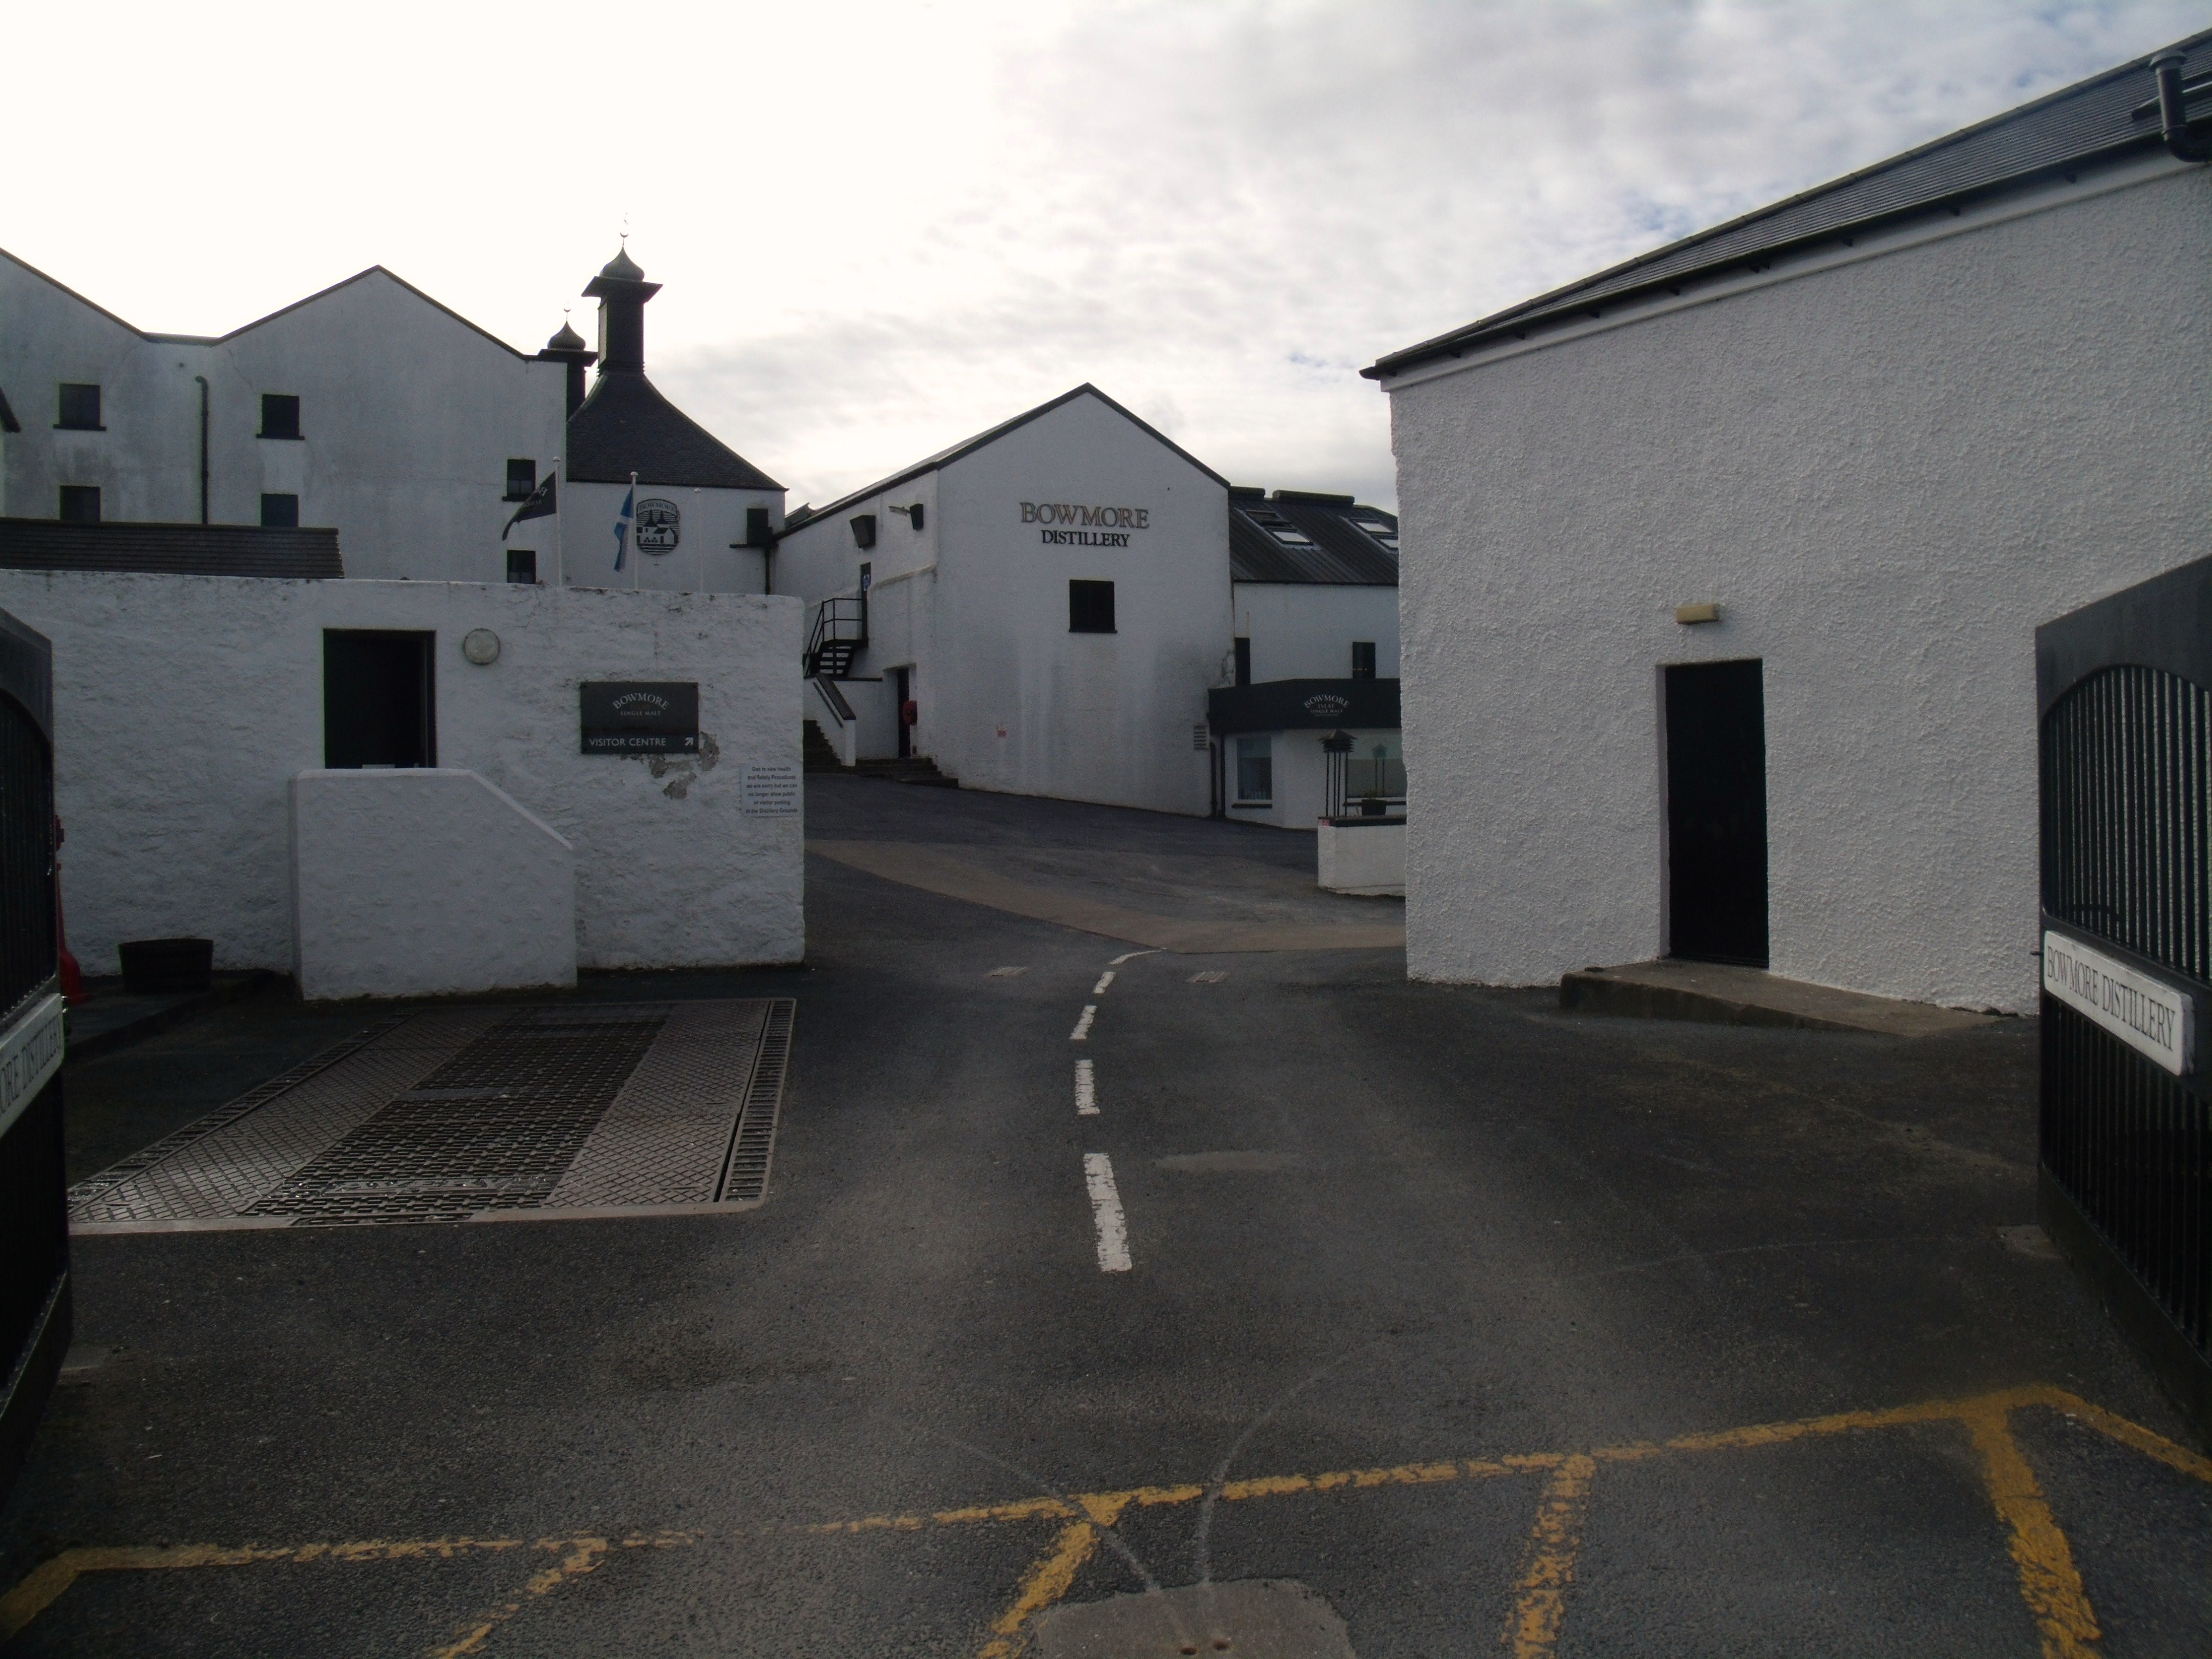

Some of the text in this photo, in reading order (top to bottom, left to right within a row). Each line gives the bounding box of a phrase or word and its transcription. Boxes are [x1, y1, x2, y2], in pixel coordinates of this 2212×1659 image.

[1020, 502, 1150, 529] BOWMORE
[1040, 529, 1130, 547] DISTILLERY
[612, 692, 670, 710] BOWMORE
[1304, 694, 1350, 709] BOWMORE
[589, 738, 667, 747] VISITOR CENTRE
[2047, 946, 2176, 1051] BOWMORE DISTILLERY
